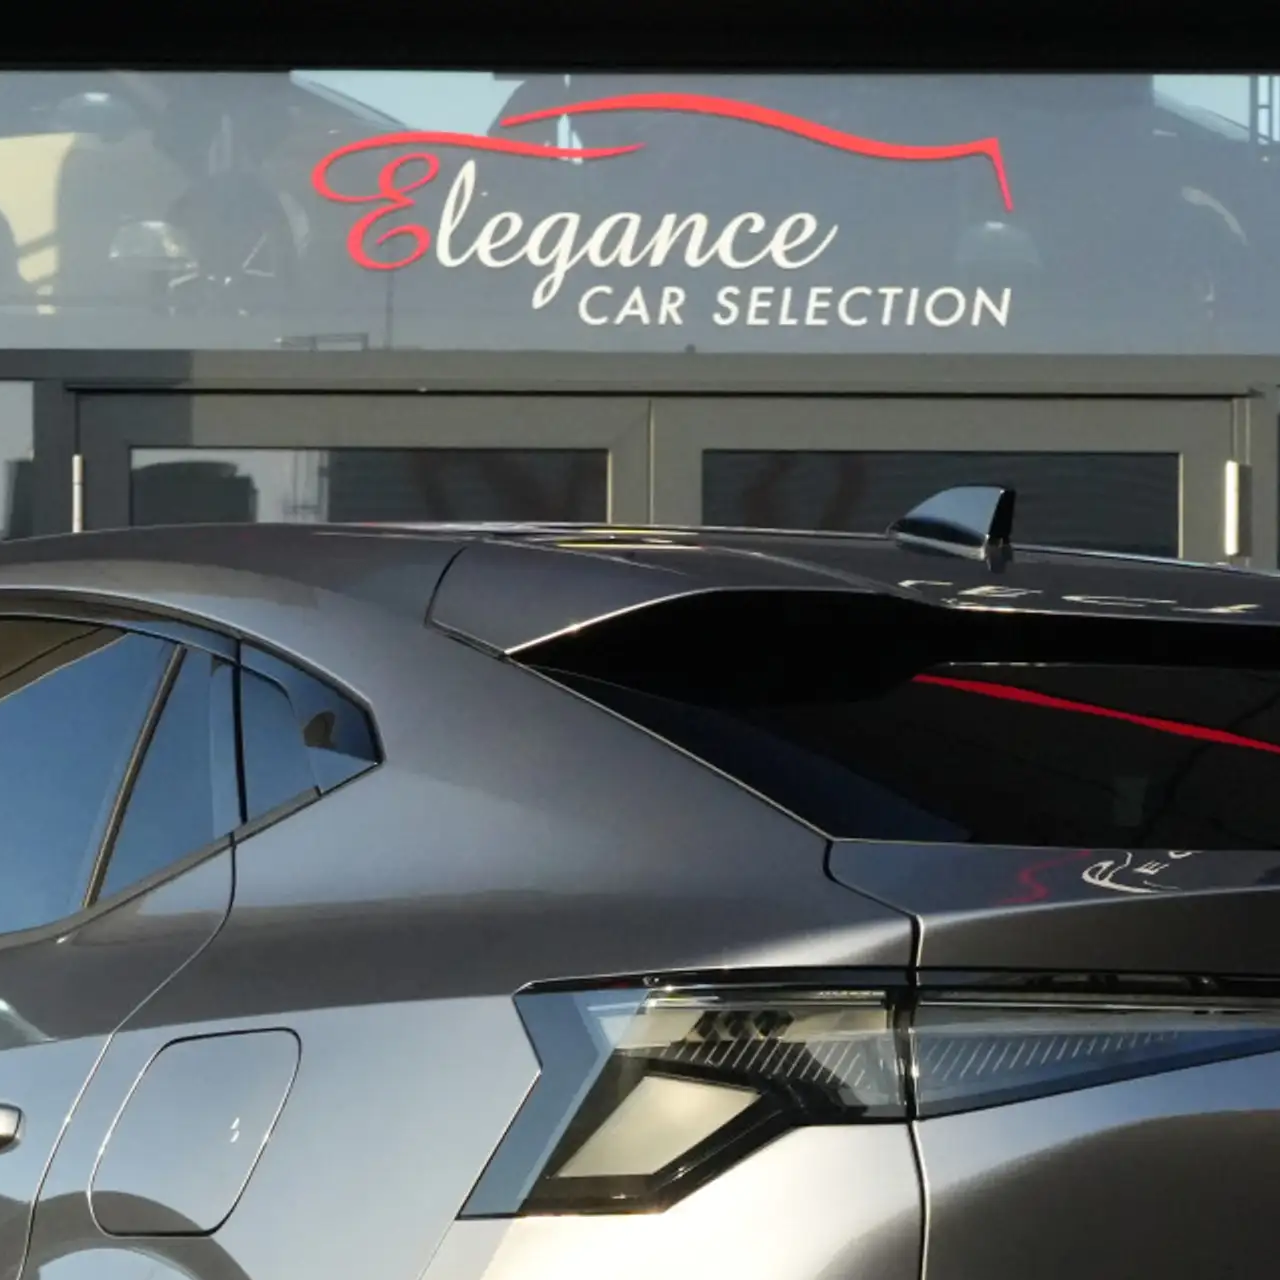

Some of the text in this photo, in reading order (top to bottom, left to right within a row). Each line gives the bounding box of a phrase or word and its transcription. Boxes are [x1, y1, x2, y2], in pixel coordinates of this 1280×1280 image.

[312, 131, 838, 310] Elegance
[578, 285, 1012, 328] CAR SELECTION
